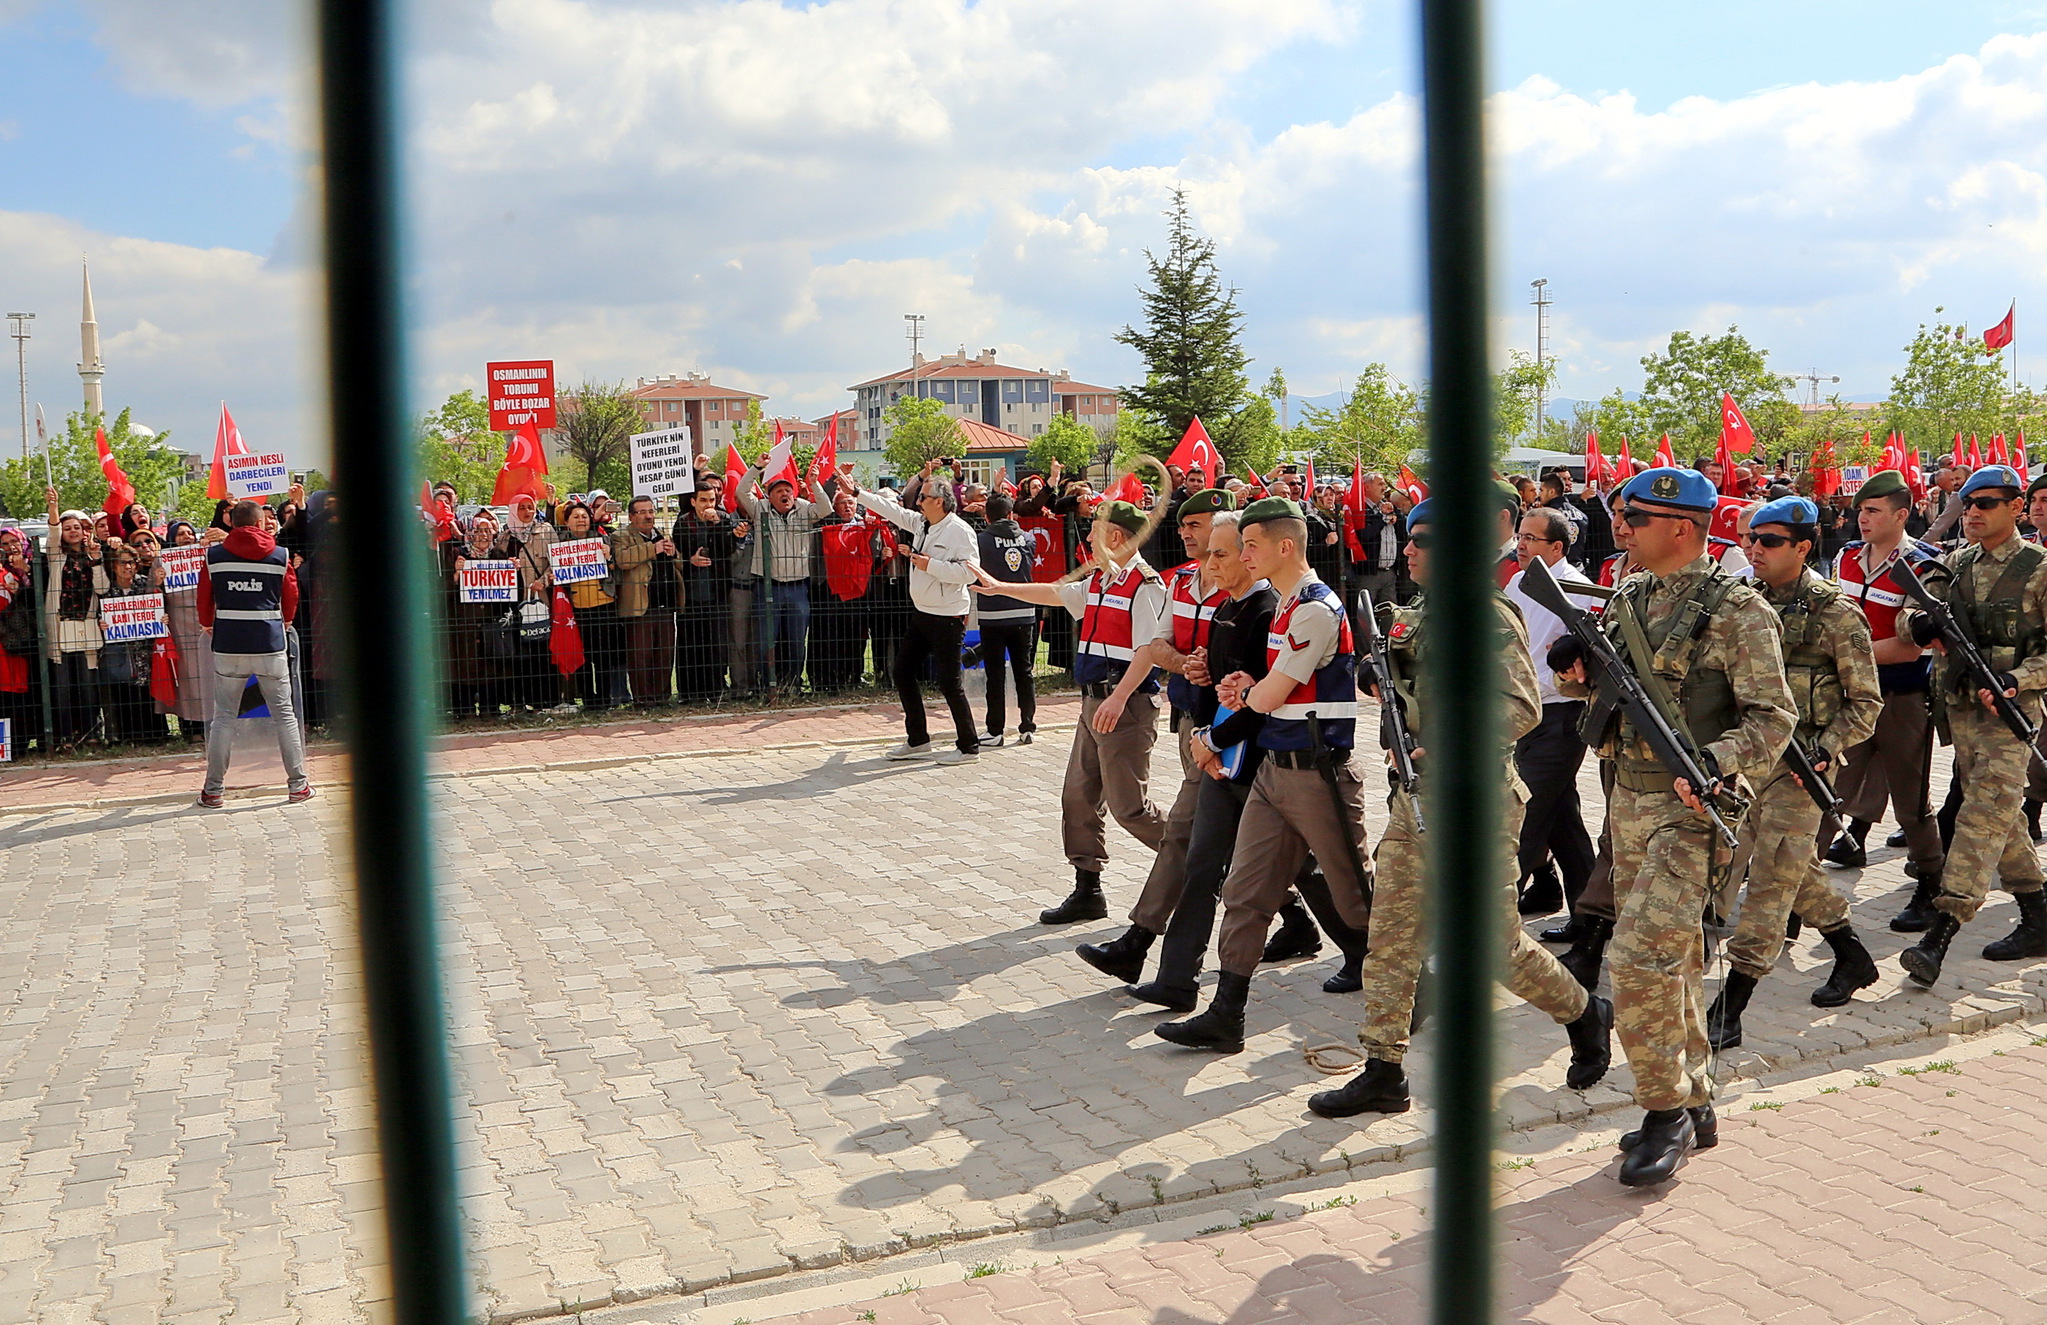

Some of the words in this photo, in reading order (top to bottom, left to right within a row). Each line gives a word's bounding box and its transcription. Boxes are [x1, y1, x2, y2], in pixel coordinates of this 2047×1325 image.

[494, 368, 547, 380] OSMANLININ
[503, 383, 538, 395] TORUNU
[494, 398, 520, 410] BÖYLE
[522, 398, 550, 409] BOZAR
[636, 435, 668, 448] TÜRKİYE
[670, 432, 683, 442] NİN
[642, 445, 680, 459] NEFERLERİ
[228, 457, 258, 469] ASIMIN
[260, 453, 284, 465] NESLİ
[637, 461, 662, 472] OYUNU
[664, 455, 686, 467] YENDİ
[229, 466, 285, 481] DARBECİLERİ
[639, 472, 663, 483] HESAP
[665, 467, 686, 479] GÜNÜ
[246, 481, 272, 492] YENDİ
[653, 482, 674, 493] GELDİ
[577, 554, 597, 563] YERDE
[171, 562, 189, 573] KANI
[555, 563, 606, 581] KALMASIN
[167, 572, 200, 589] KALM
[462, 567, 515, 586] TÜRKİYE
[227, 578, 263, 591] POLİS
[468, 589, 511, 599] YENİLMEZ
[112, 614, 130, 624] KANI
[131, 611, 156, 622] YERDE
[107, 622, 164, 641] KALMASIN
